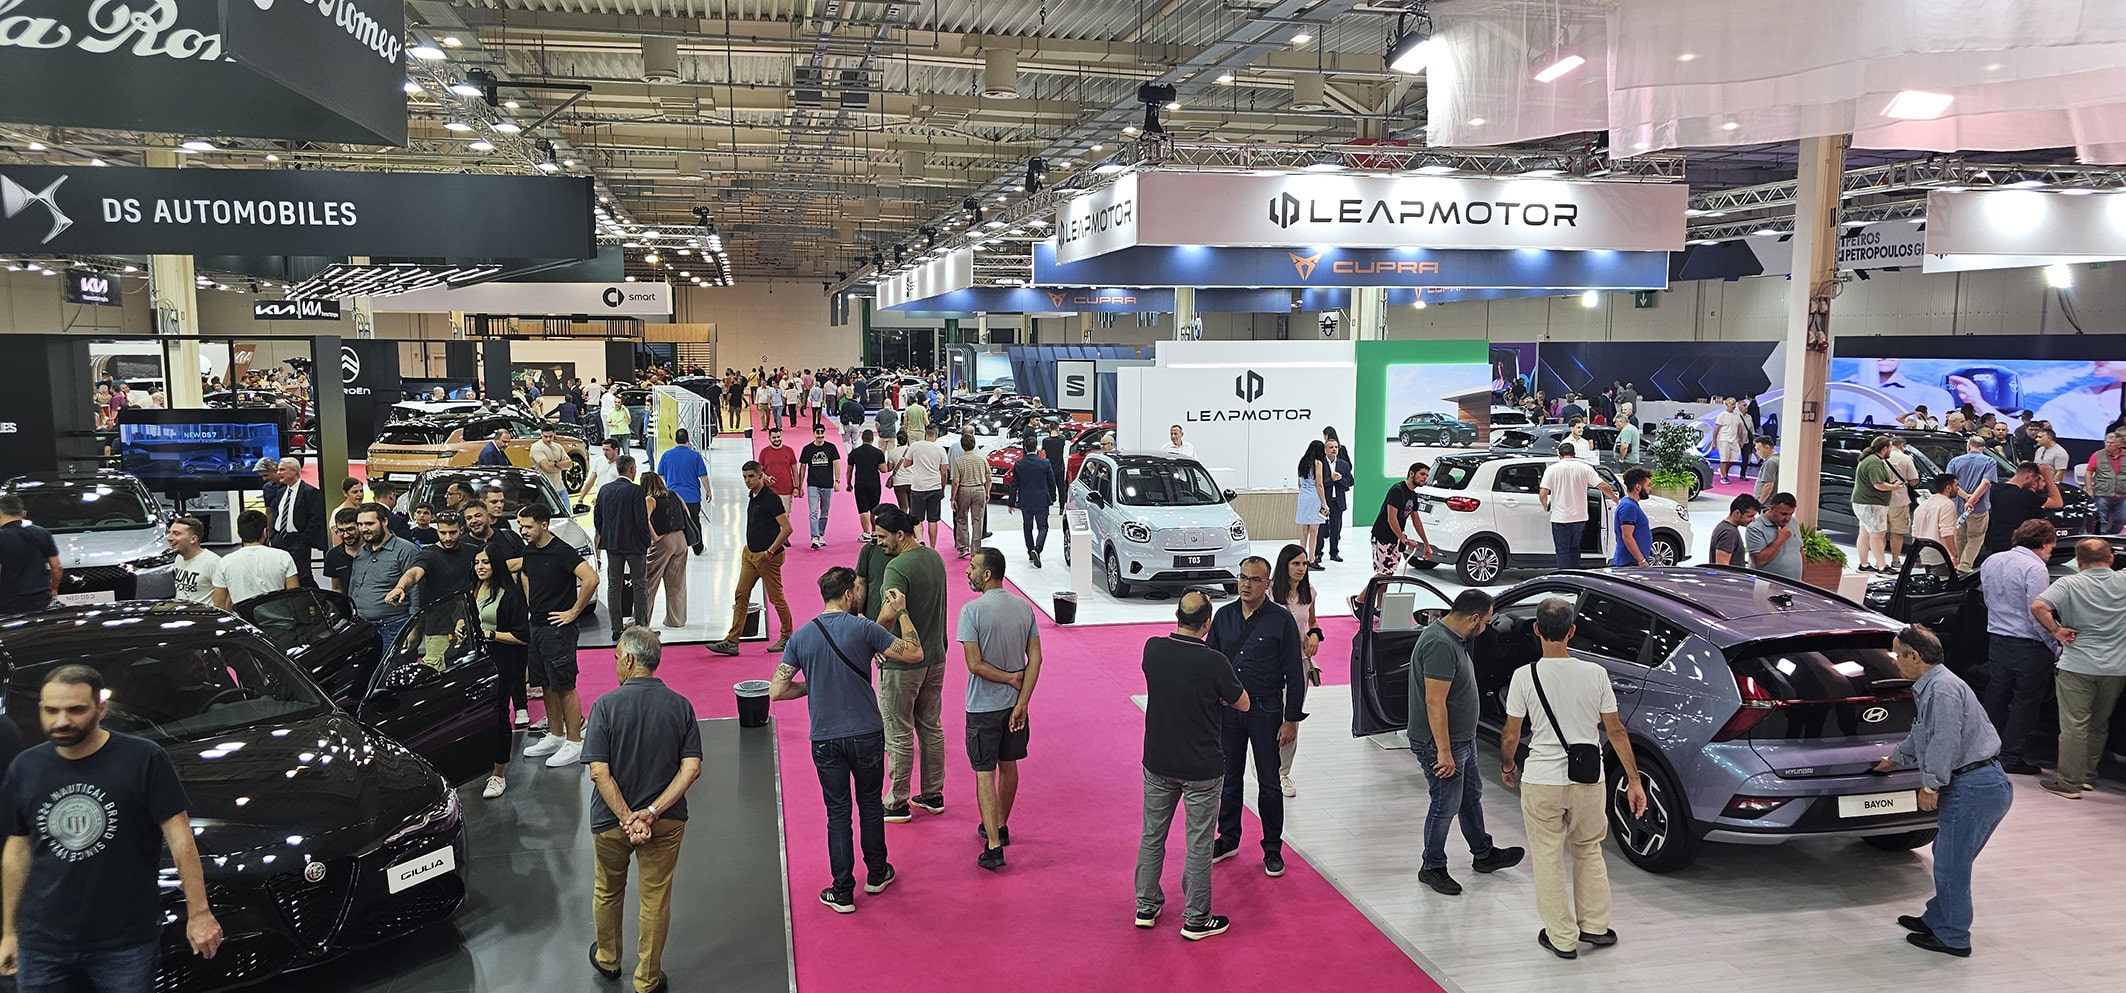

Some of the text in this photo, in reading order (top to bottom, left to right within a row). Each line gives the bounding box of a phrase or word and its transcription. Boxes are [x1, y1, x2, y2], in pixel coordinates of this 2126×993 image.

[102, 197, 357, 226] DS AUTOMOBILES
[1309, 199, 1578, 227] LEAPMOTOR
[1065, 199, 1132, 244] LEAPMOTOR
[1846, 243, 1913, 261] PETROPOULOS
[1332, 261, 1439, 275] CUPRA
[628, 293, 656, 301] smart
[1073, 296, 1137, 305] CUPRA
[1186, 409, 1312, 422] LEAPMOTOR
[1188, 556, 1201, 564] T03
[50, 783, 106, 801] NAUTICAL
[1864, 799, 1894, 809] BAYON
[104, 802, 118, 839] BRAND
[69, 842, 105, 861] SINCE
[402, 859, 444, 880] GIULIA
